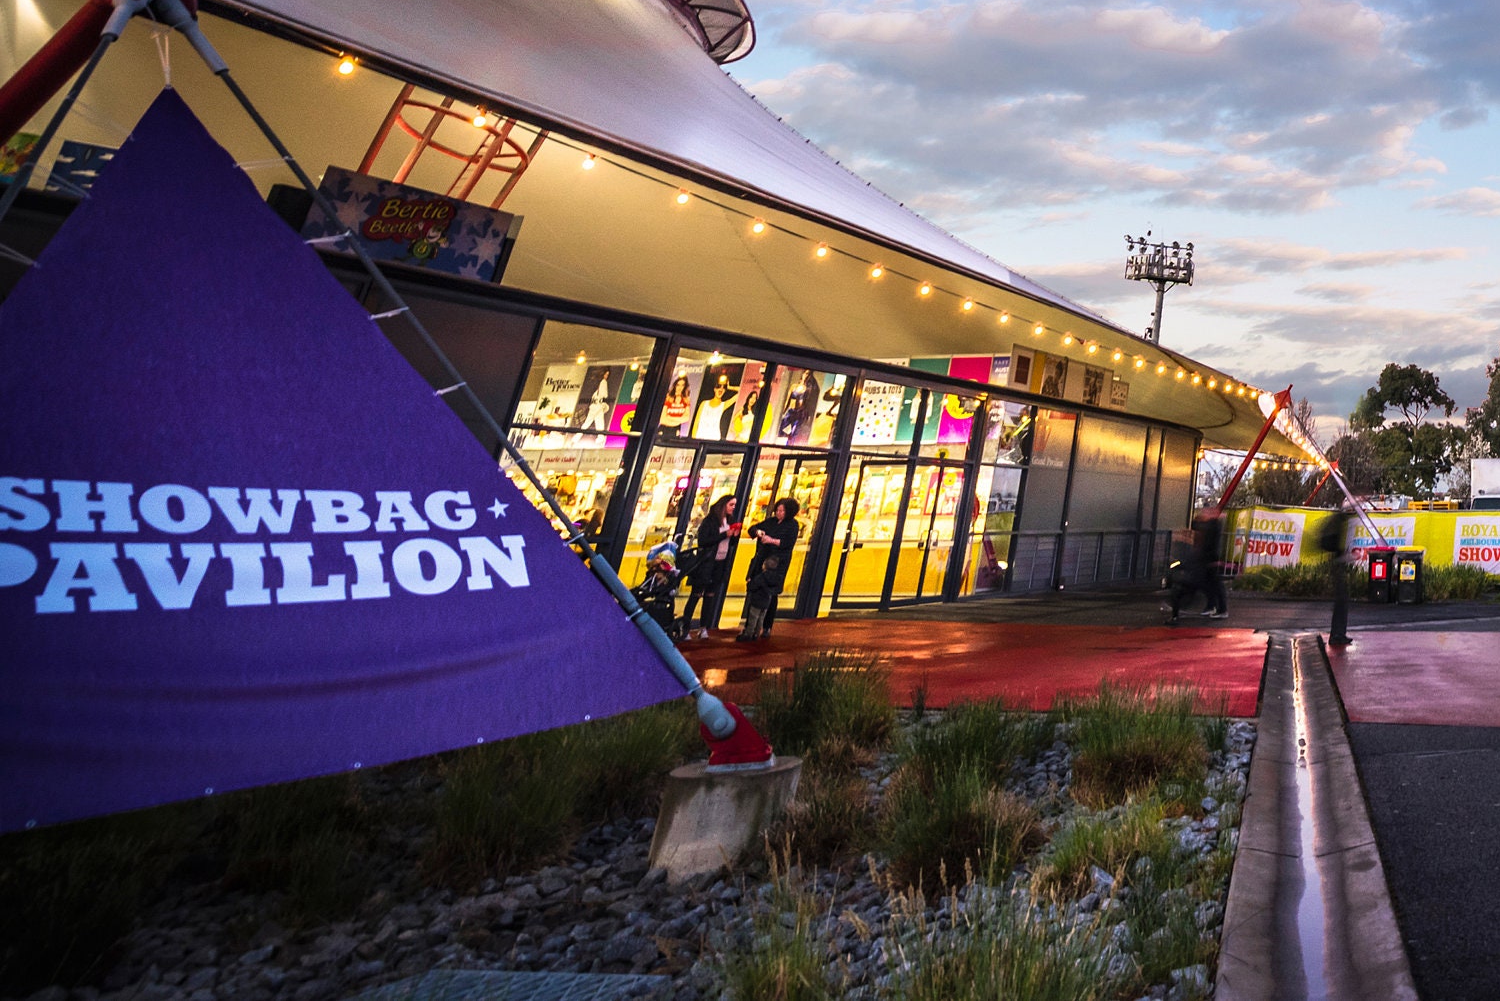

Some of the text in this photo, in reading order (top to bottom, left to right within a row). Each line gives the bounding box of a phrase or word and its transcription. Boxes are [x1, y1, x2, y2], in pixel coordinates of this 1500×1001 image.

[381, 199, 449, 220] Bertie
[369, 219, 420, 235] Beetle
[551, 383, 580, 393] Homes
[0, 477, 478, 535] SHOWBAG
[1251, 518, 1297, 534] ROYAL
[1247, 540, 1294, 557] SHOW
[1353, 538, 1406, 546] MELBRNE
